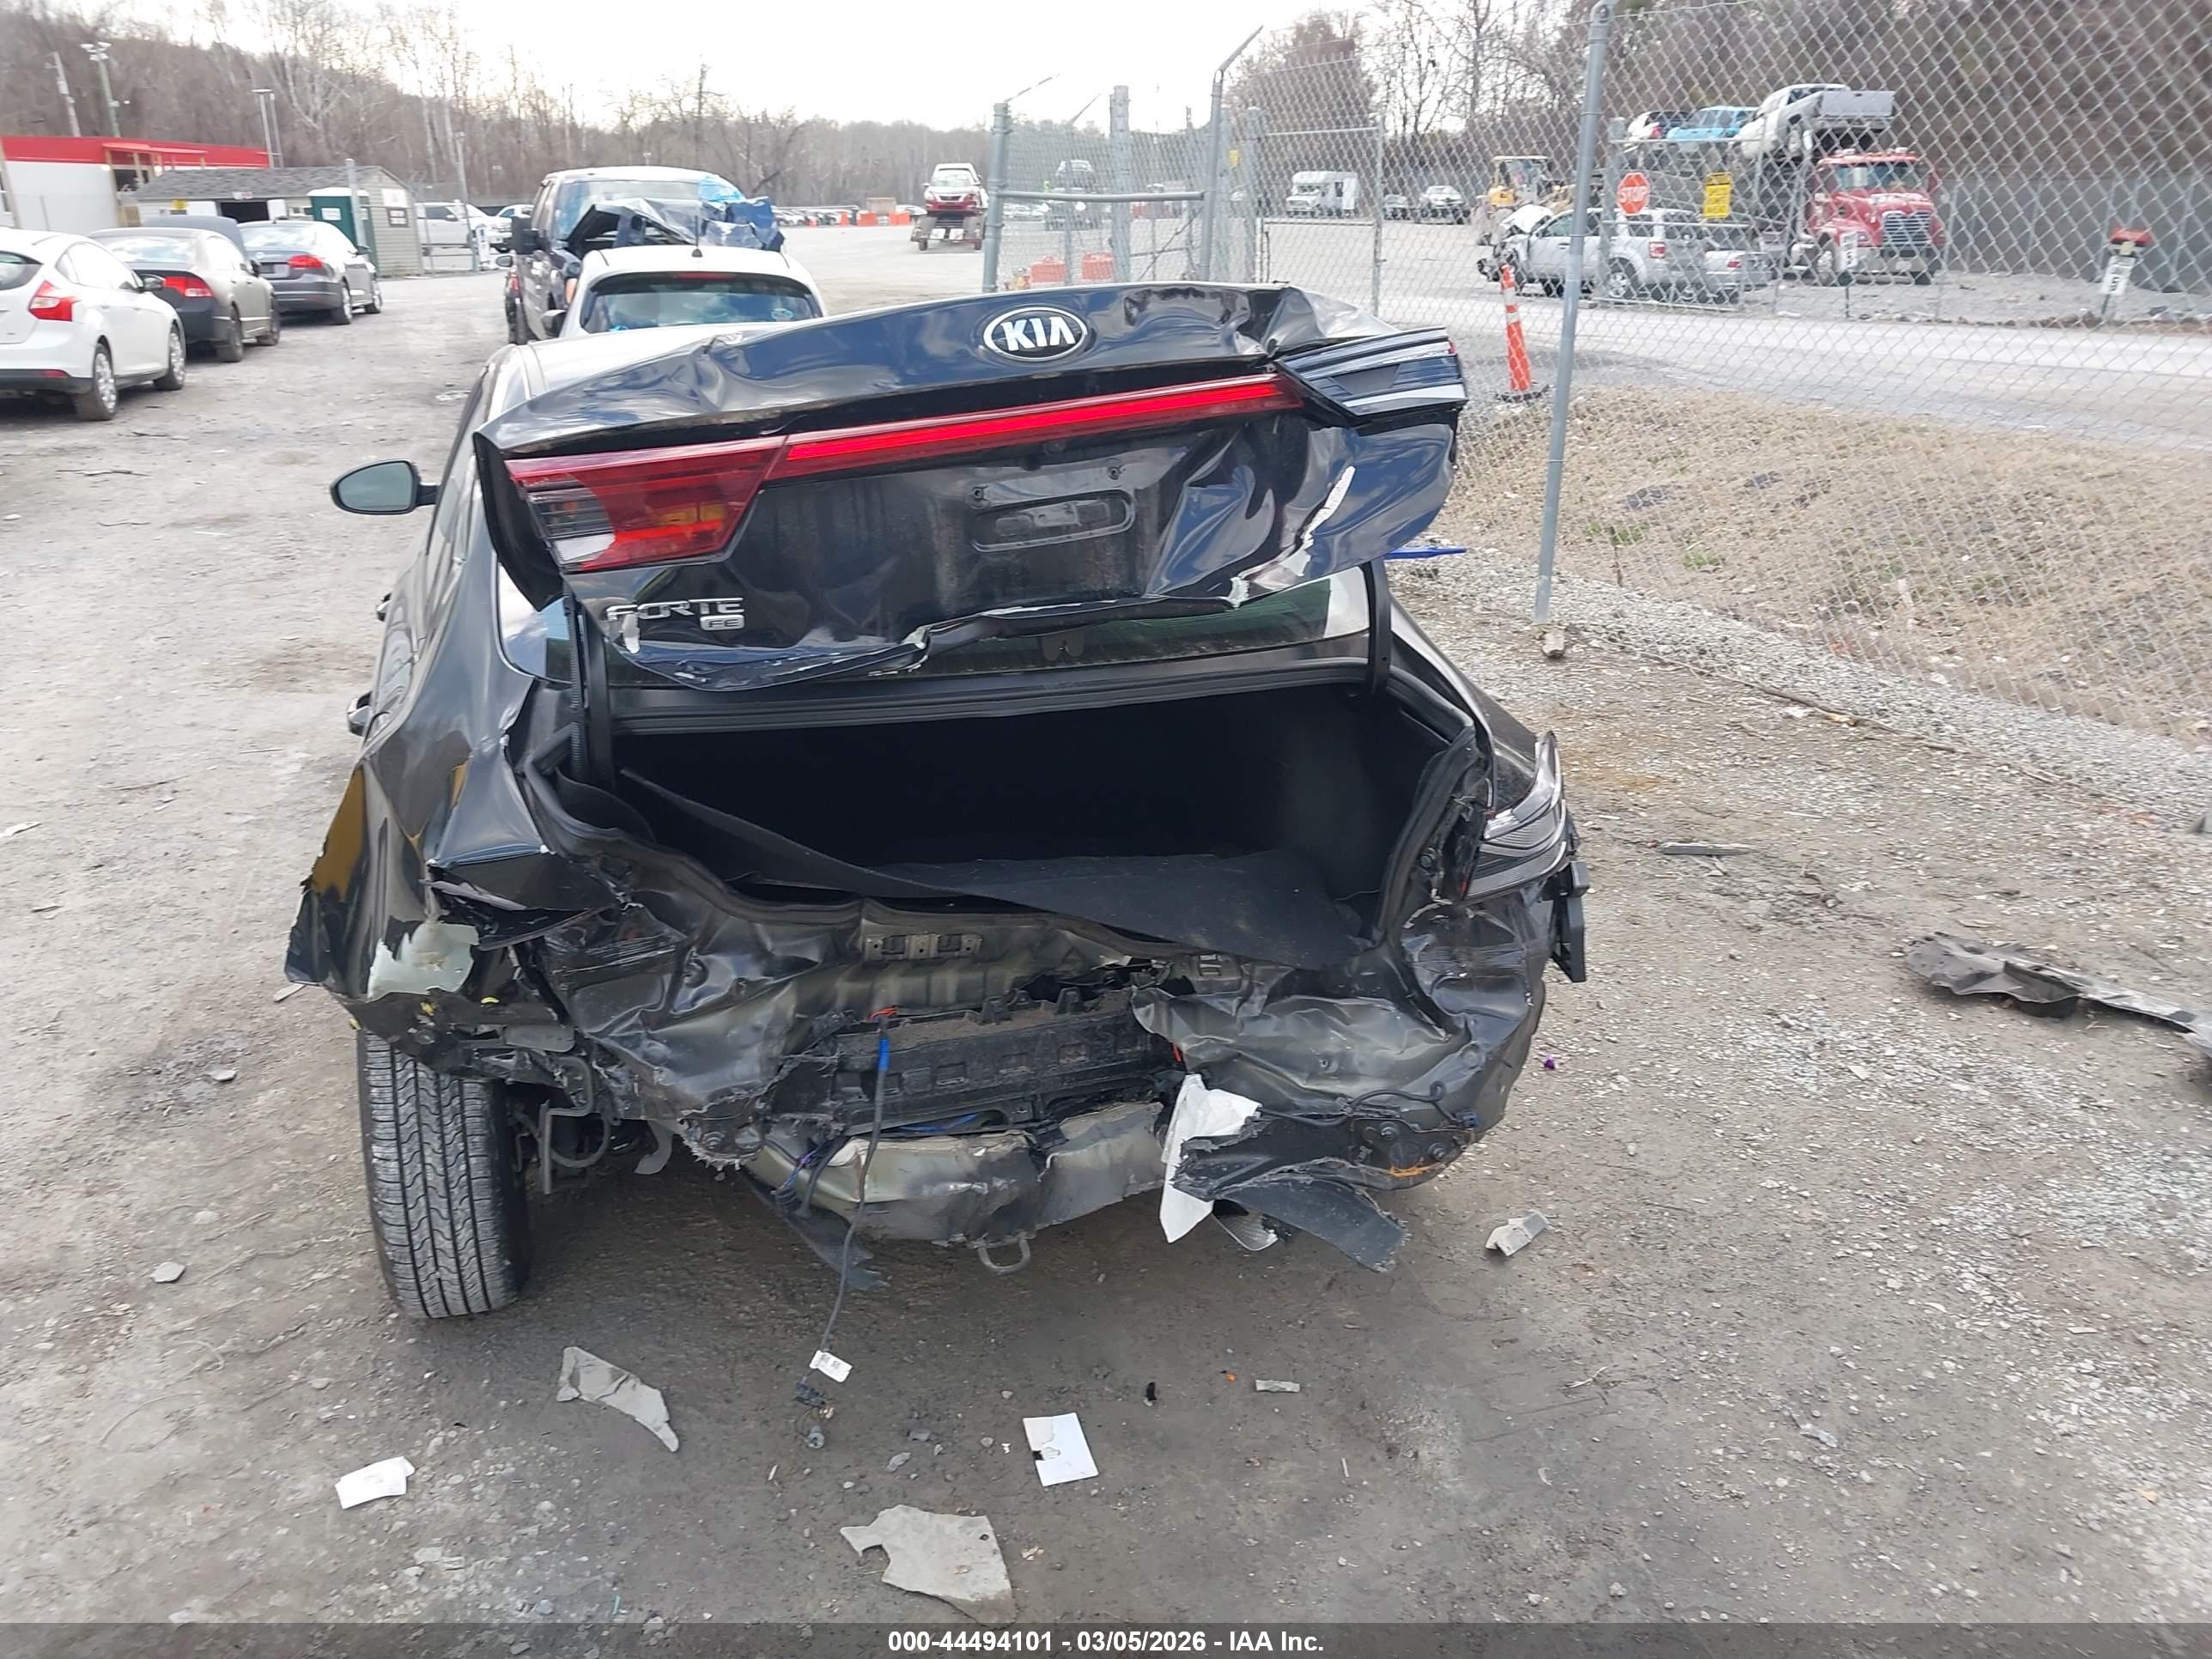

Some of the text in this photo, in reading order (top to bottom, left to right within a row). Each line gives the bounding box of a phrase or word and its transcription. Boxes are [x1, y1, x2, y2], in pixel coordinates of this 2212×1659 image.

[1619, 185, 1647, 204] STOP
[1000, 316, 1076, 351] KIA
[605, 598, 744, 622] FORTE
[708, 617, 741, 629] FE
